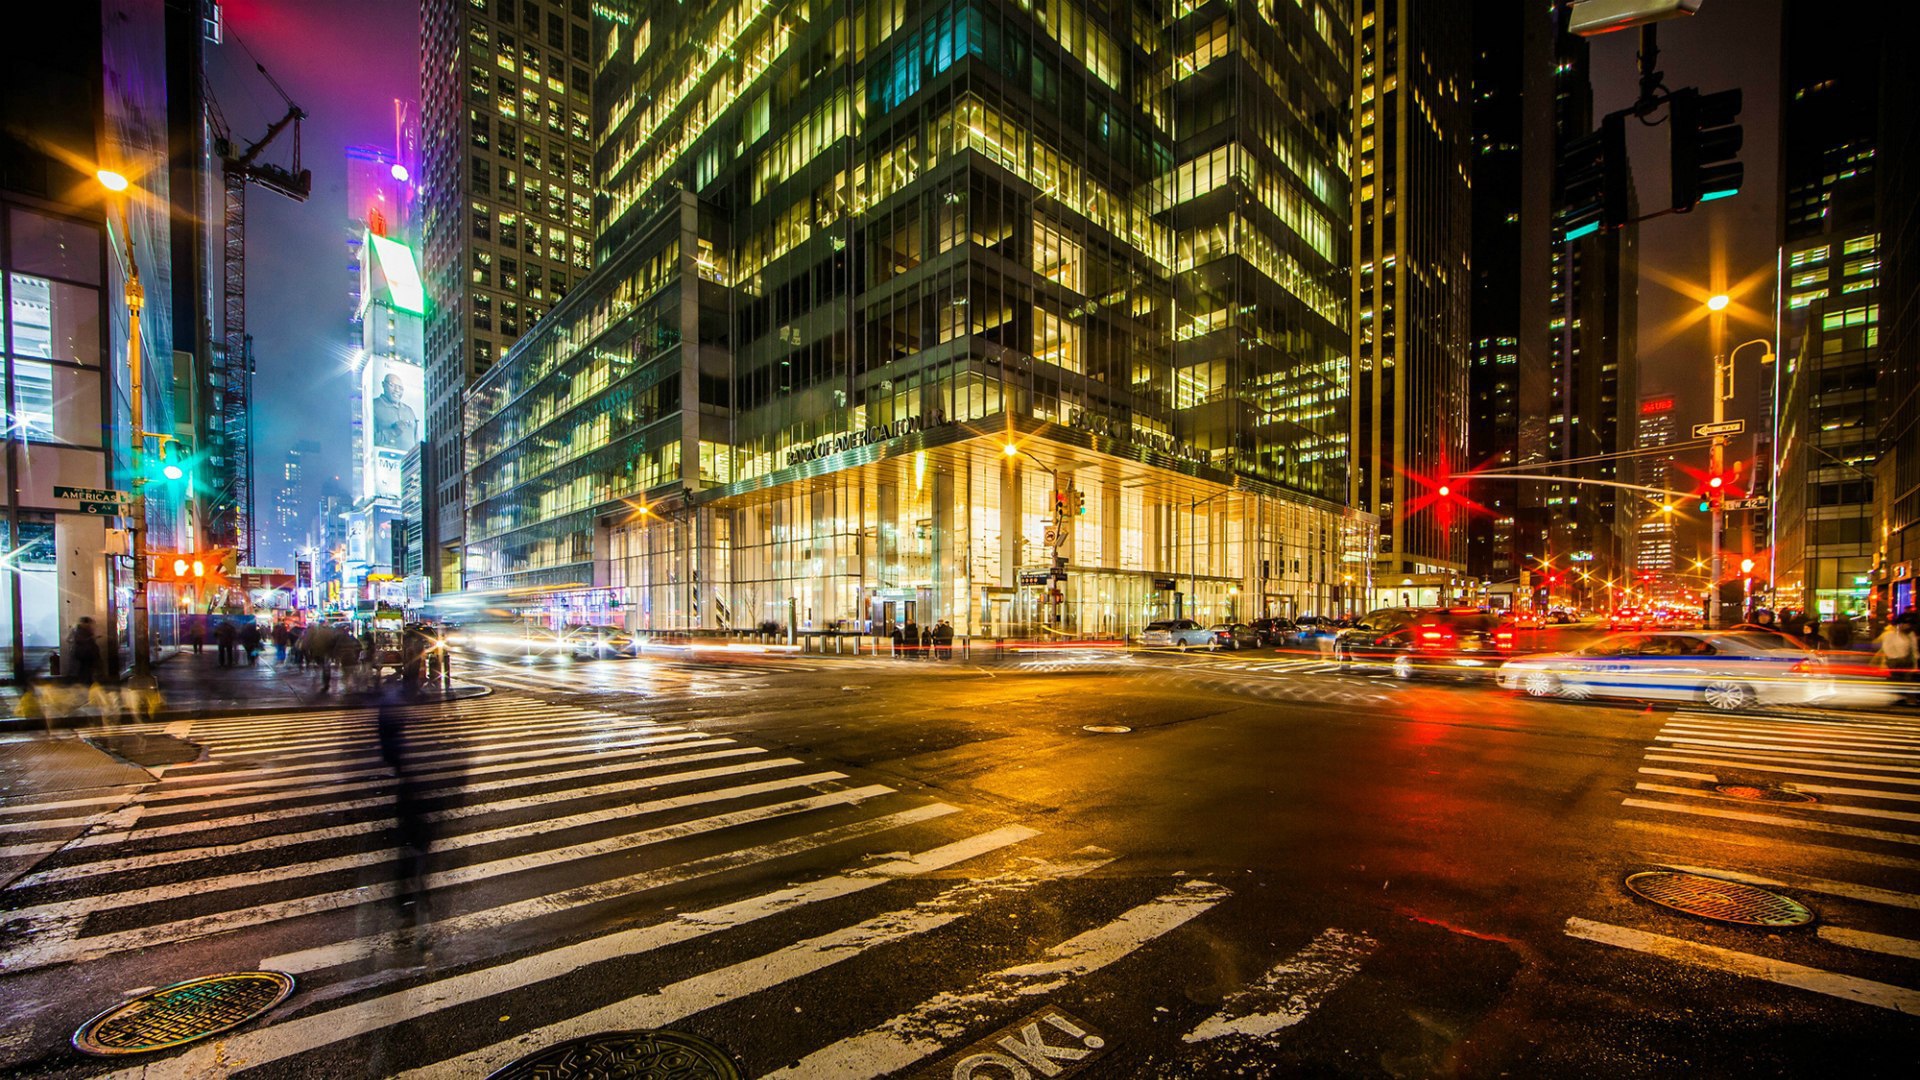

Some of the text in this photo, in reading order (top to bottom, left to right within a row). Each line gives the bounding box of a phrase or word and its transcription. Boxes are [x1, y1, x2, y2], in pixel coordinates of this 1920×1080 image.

[819, 441, 834, 457] OF
[62, 491, 117, 502] AMERICAS
[87, 504, 97, 513] 6
[1745, 499, 1758, 508] 42
